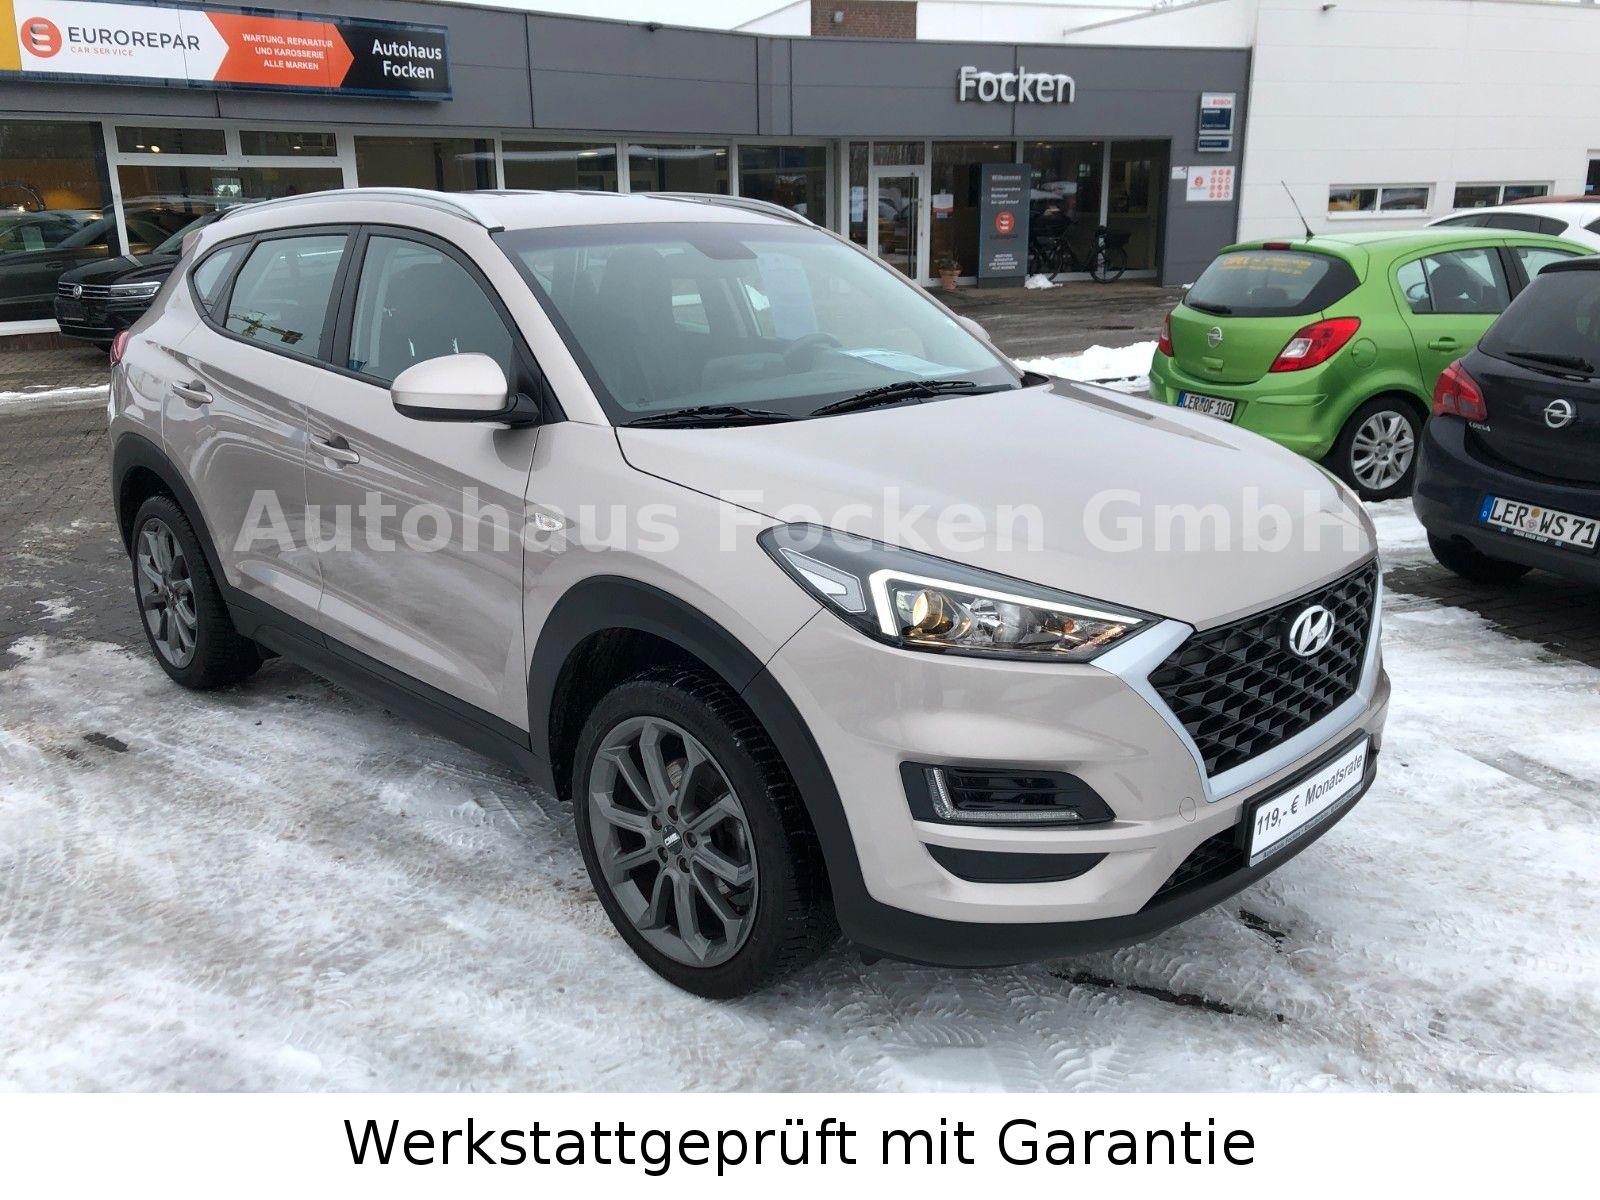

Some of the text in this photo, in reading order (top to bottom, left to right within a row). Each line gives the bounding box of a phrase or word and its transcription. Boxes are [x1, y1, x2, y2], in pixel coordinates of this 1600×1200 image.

[68, 26, 201, 51] EUROREPAR
[242, 33, 333, 48] WARTUNG, REPARATUR
[70, 46, 134, 57] CAR SERVICE
[255, 46, 325, 59] UND KAROSSERIE
[371, 39, 442, 60] Autohaus
[264, 59, 320, 71] ALLE MARKEN
[382, 59, 435, 80] Focken
[960, 66, 1075, 103] Focken
[1183, 394, 1199, 411] LER
[1215, 401, 1233, 417] 100
[1490, 500, 1529, 528] LER
[1540, 511, 1568, 537] WS
[1570, 519, 1597, 546] 71
[1304, 754, 1363, 807] Monatsrate
